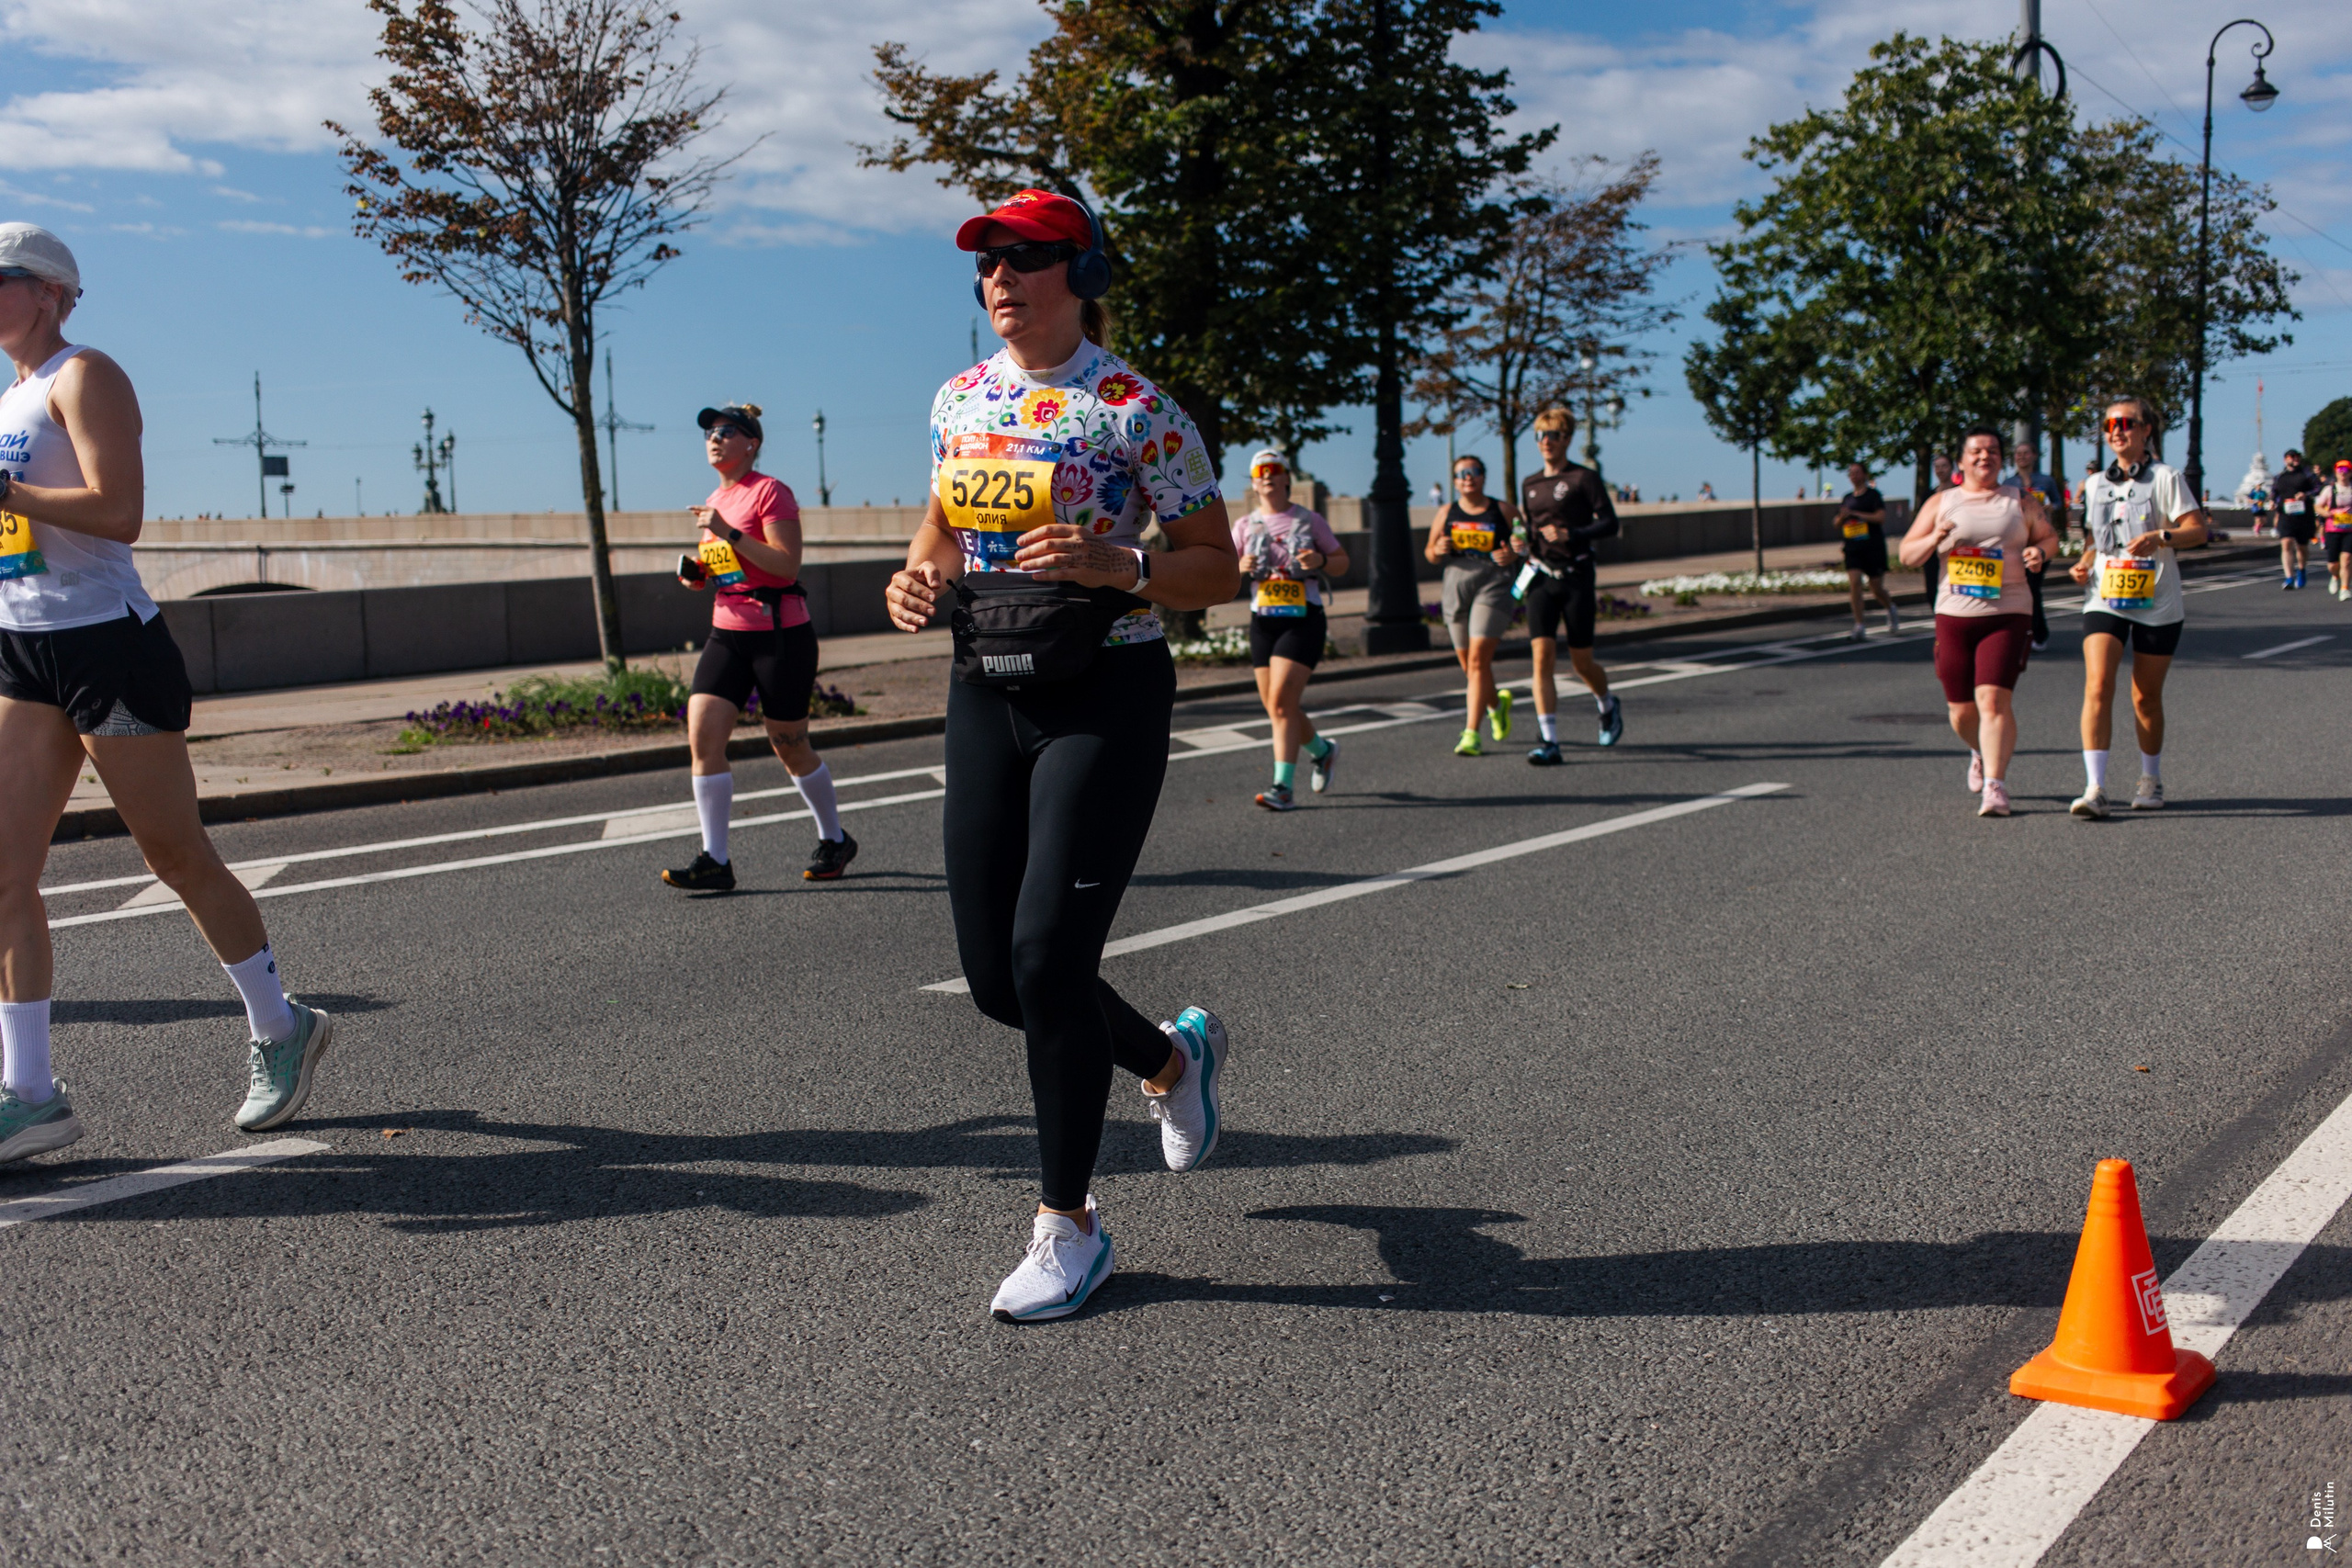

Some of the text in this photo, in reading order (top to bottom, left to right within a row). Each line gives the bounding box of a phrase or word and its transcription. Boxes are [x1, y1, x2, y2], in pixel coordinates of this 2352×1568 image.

[0, 430, 29, 449] ОЙ
[959, 442, 989, 450] МАРАФОН
[1005, 443, 1025, 453] 21,1
[0, 450, 30, 463] ВШЭ
[952, 469, 1035, 511] 5225
[976, 513, 1007, 525] ЮЛИЯ
[1457, 534, 1488, 547] 4153
[704, 547, 730, 566] 2262
[1955, 559, 1996, 577] 2408
[2109, 573, 2148, 590] 1357
[1264, 583, 1300, 598] 4998
[982, 653, 1035, 672] PUMA
